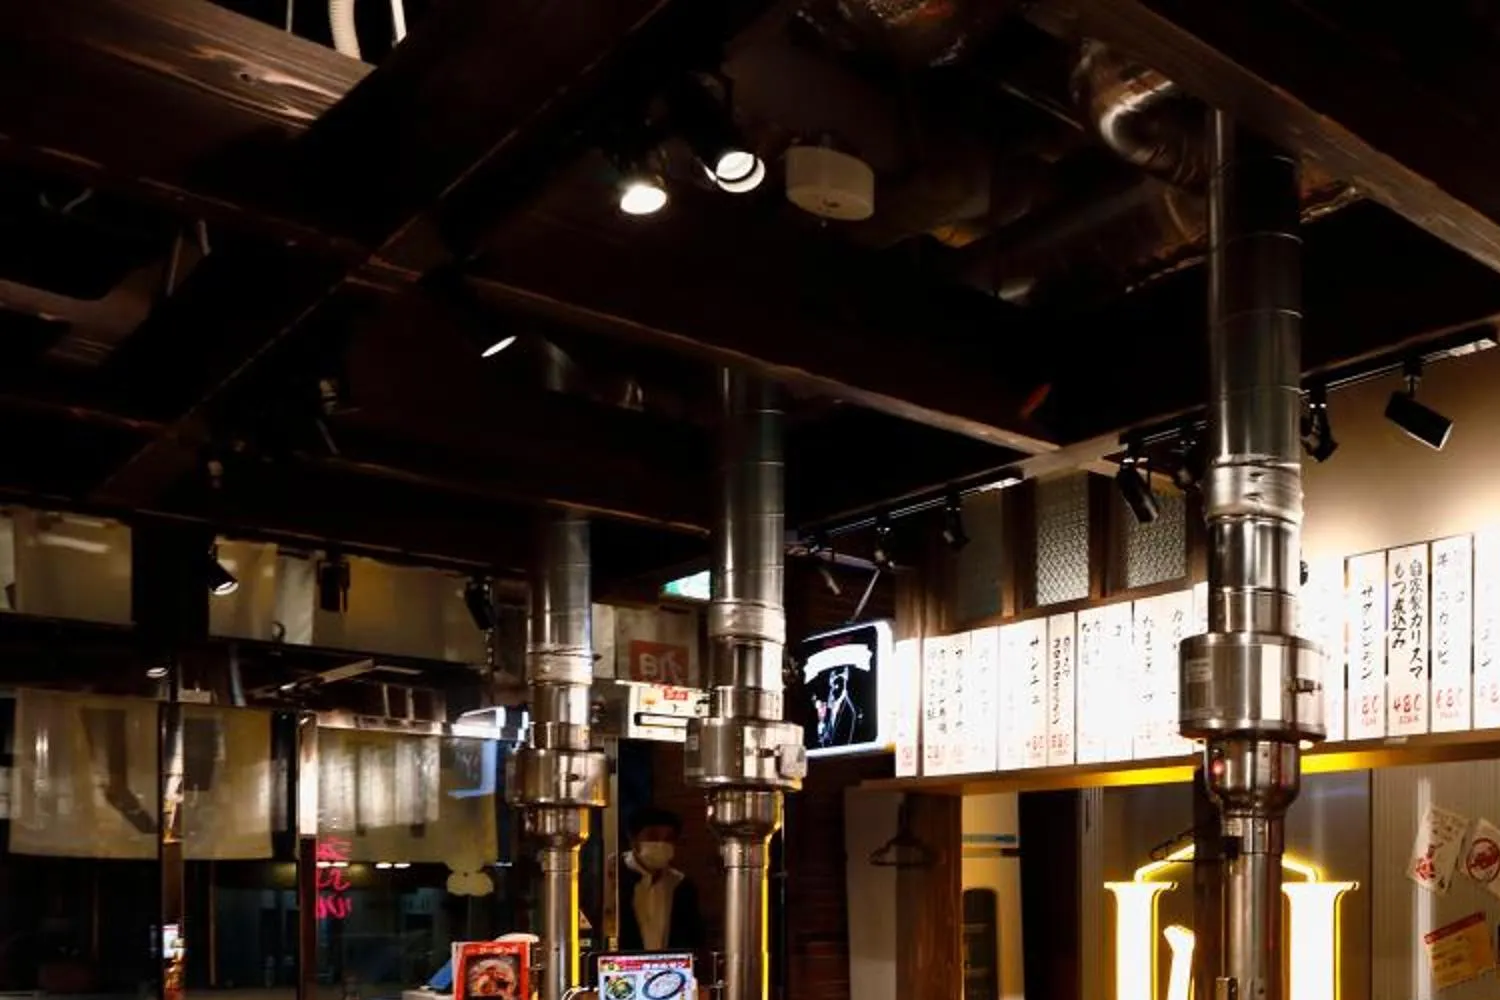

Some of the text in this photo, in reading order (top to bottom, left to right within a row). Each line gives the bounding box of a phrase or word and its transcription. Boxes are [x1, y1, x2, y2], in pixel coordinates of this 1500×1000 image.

[1409, 558, 1424, 680] 自家製カリスマ
